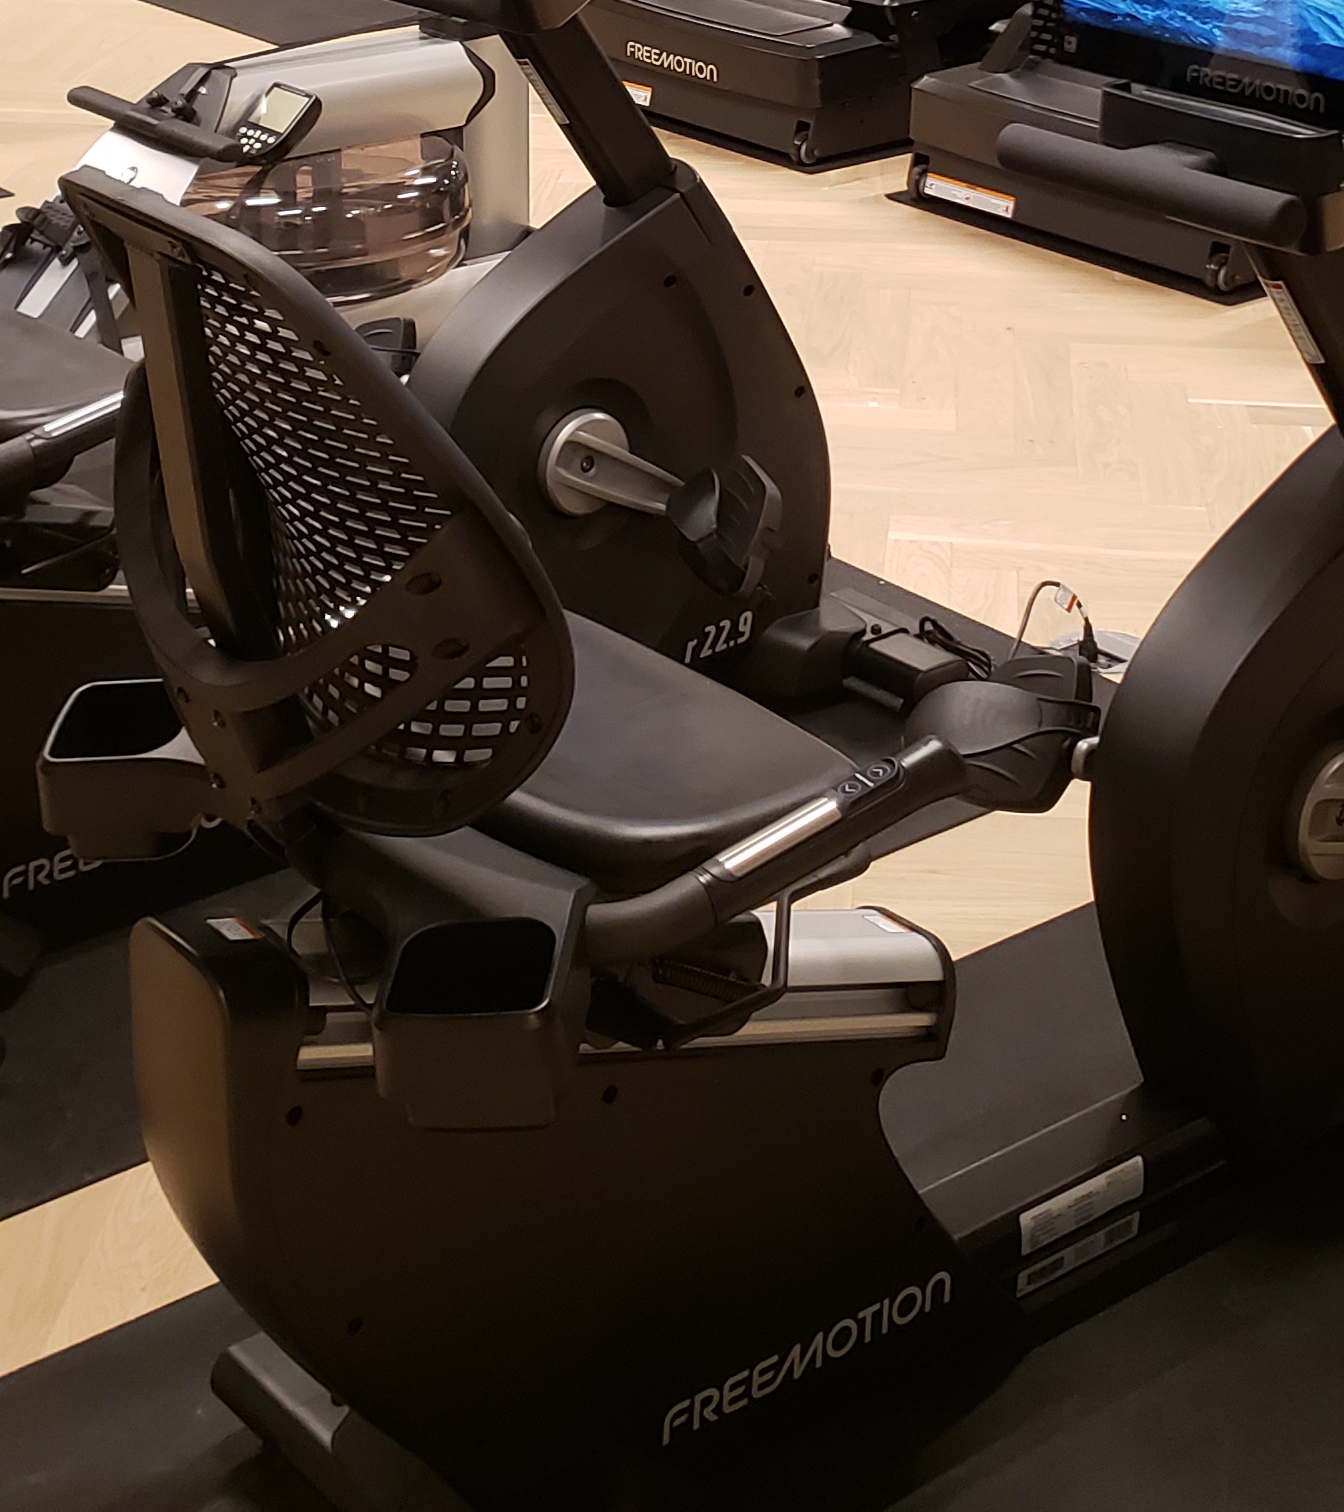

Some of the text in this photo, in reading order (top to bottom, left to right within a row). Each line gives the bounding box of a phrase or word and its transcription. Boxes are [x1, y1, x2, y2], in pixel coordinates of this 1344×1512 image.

[626, 41, 718, 82] FREEMOTION
[1186, 64, 1325, 114] FREEMOTION
[662, 1270, 951, 1447] FREEMOTION
